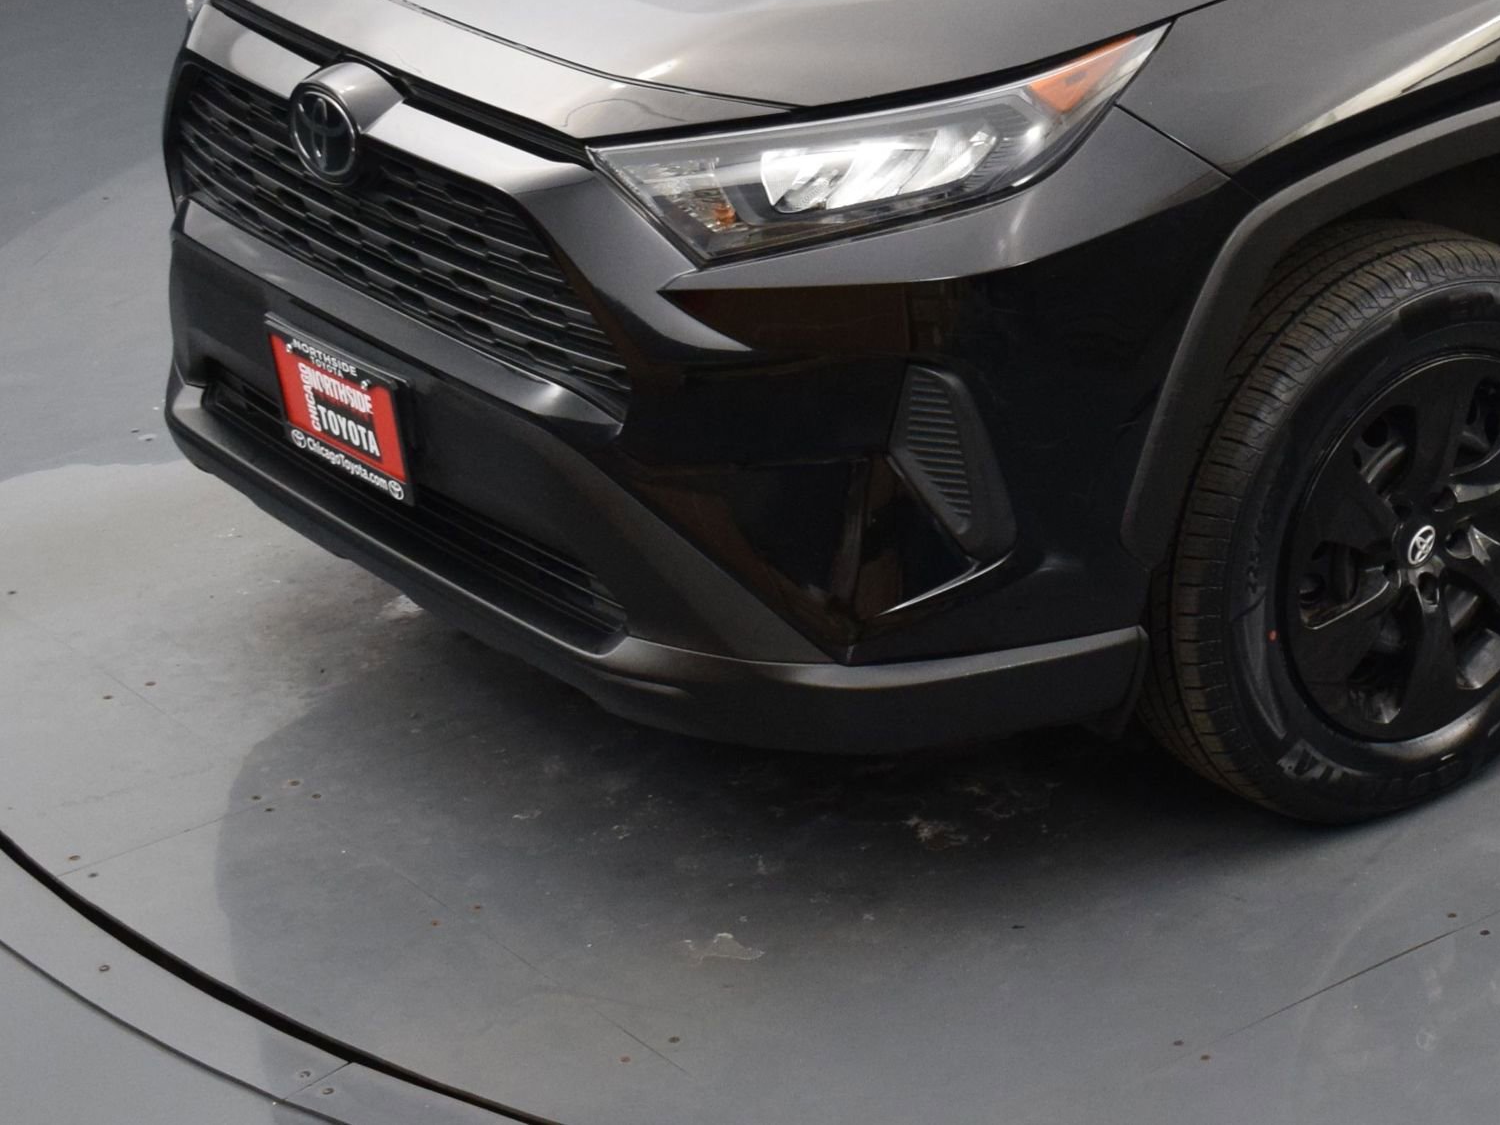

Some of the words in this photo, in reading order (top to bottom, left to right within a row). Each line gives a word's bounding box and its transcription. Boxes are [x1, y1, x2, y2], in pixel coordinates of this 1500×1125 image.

[292, 338, 358, 377] NORTHSIDE
[310, 355, 344, 378] TOYOTA
[297, 362, 322, 432] CHICAGO
[311, 368, 374, 415] NORTHSIDE
[316, 404, 380, 457] TOYOTA
[306, 437, 389, 491] ChicagoToyota.com
